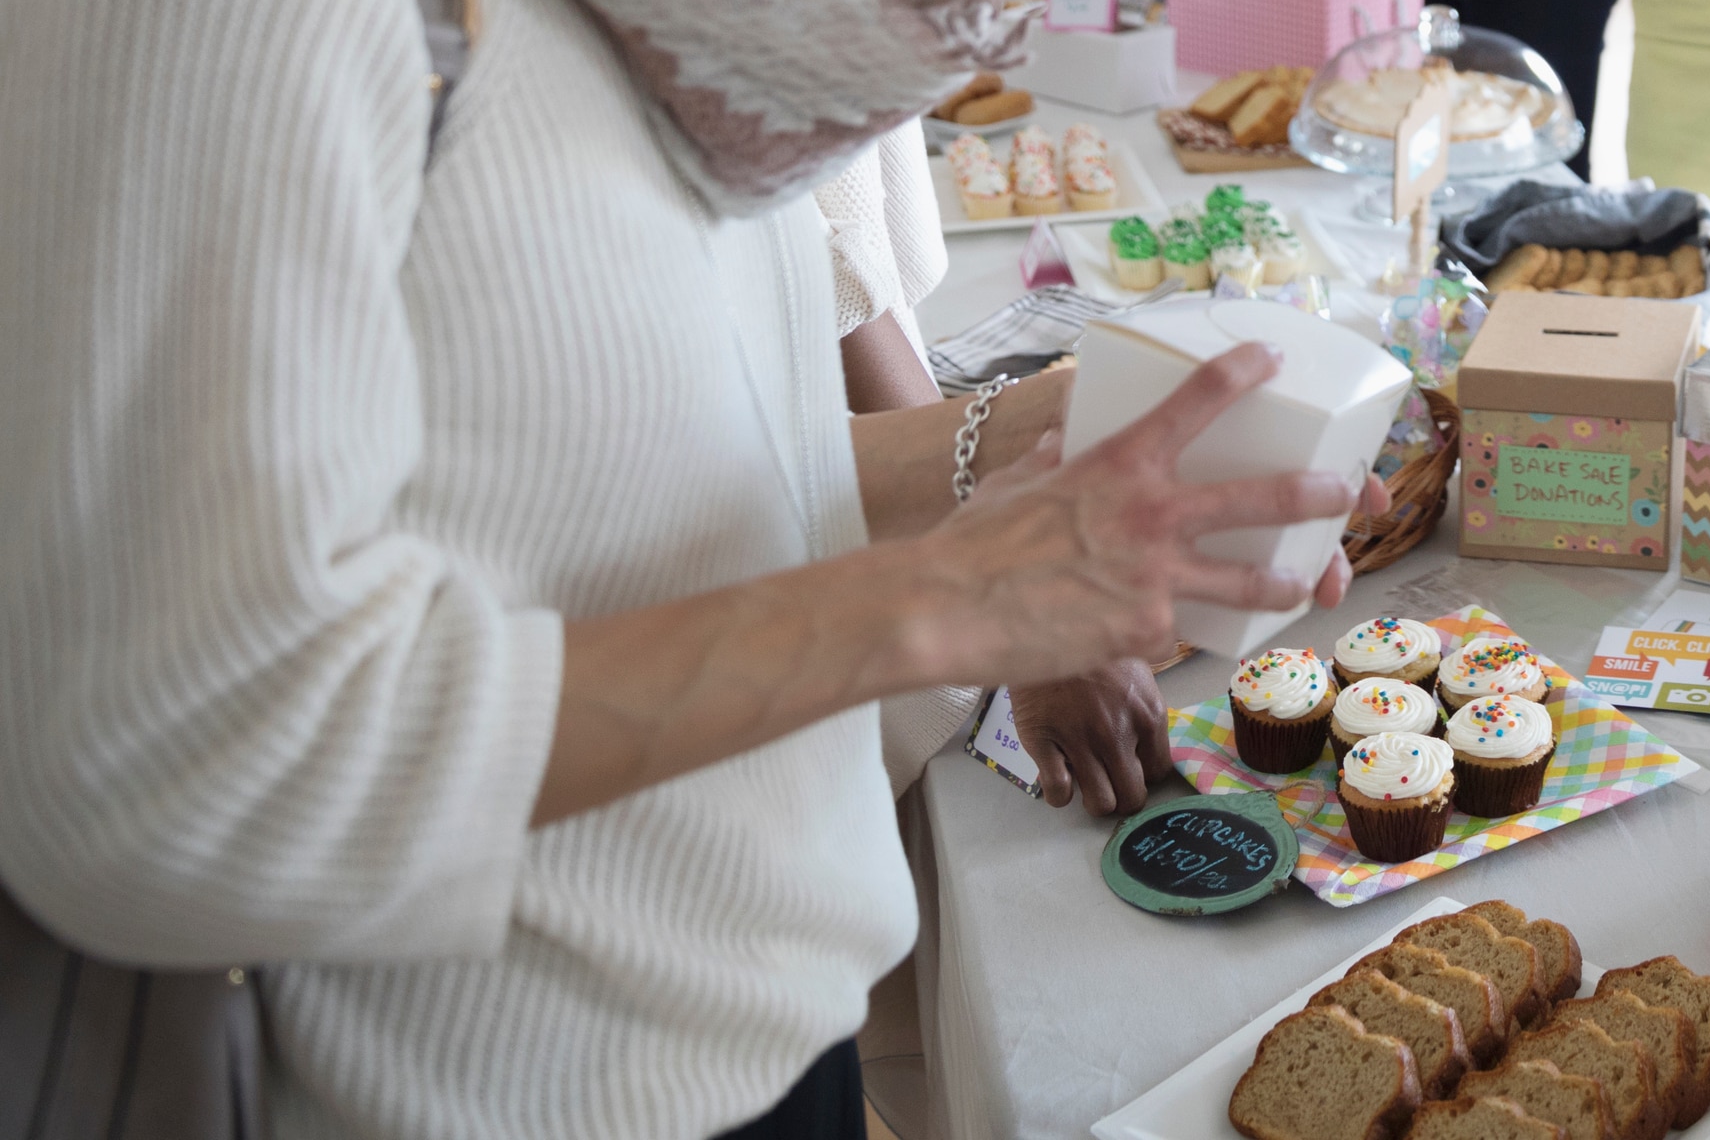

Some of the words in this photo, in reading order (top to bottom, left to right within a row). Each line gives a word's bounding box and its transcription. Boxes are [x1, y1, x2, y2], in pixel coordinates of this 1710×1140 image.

[1510, 456, 1570, 478] BAKE
[1513, 483, 1624, 511] DONATIONS
[1632, 636, 1682, 651] CLICK.
[1603, 658, 1653, 672] SMILE
[1586, 680, 1647, 697] SN@P!
[1166, 812, 1273, 872] CUPCAKES
